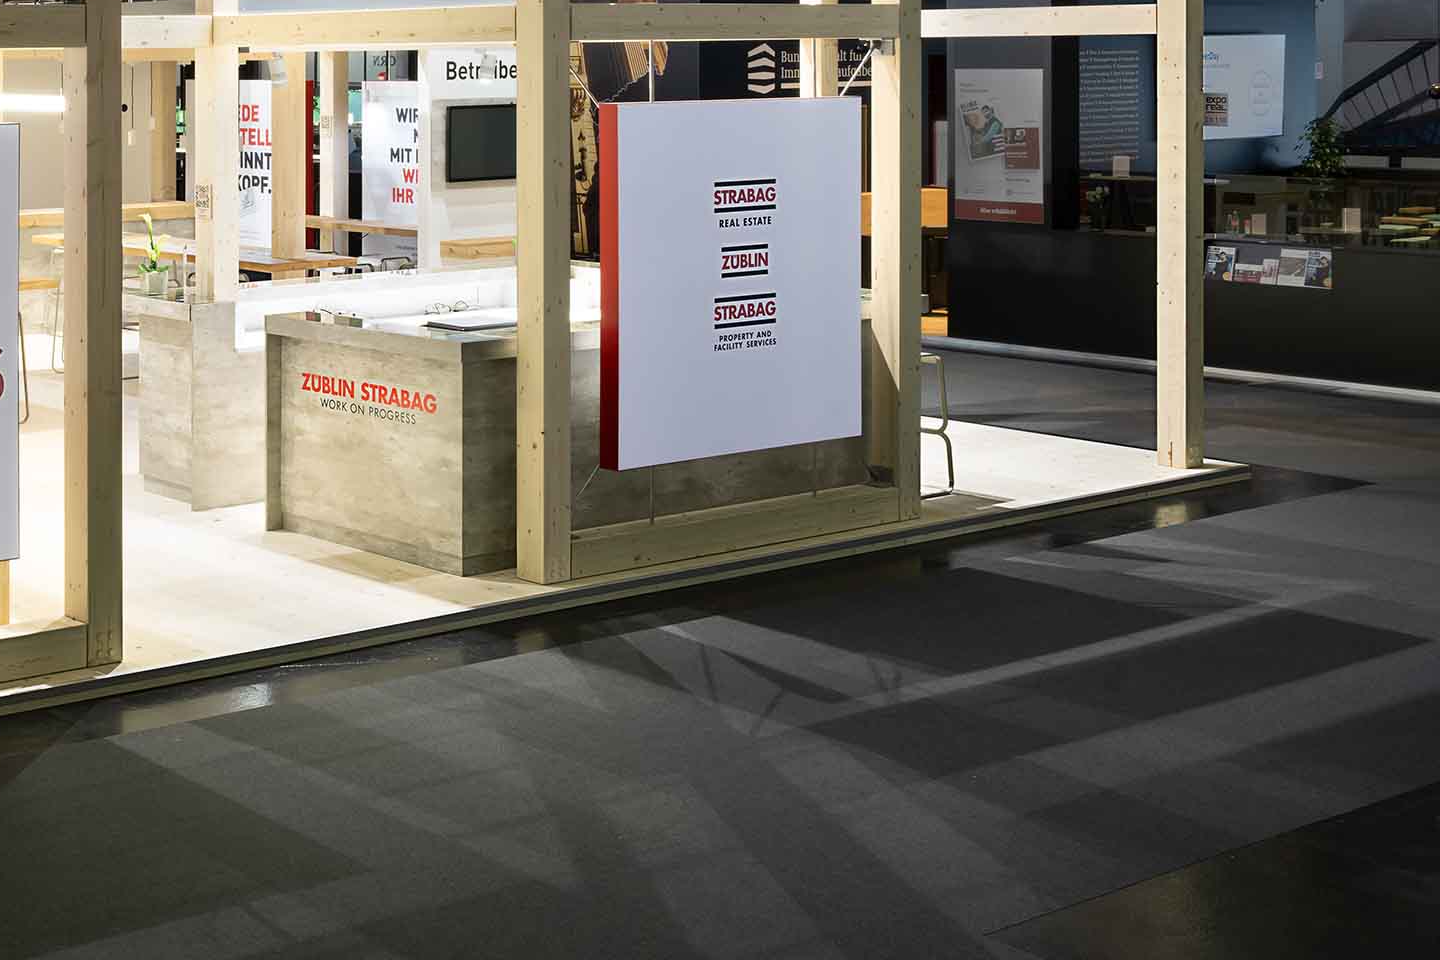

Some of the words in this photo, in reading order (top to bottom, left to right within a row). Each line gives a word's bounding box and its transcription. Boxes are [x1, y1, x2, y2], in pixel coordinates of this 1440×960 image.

[446, 59, 518, 81] Betribe
[390, 147, 412, 163] MIT
[392, 187, 414, 204] IHR
[714, 186, 776, 205] STRABAG
[719, 217, 740, 228] REAL
[743, 215, 772, 227] ESTATE
[721, 251, 769, 270] ZÜBLIN
[714, 300, 776, 321] STRABAG
[714, 341, 743, 352] FACILITY
[746, 338, 777, 349] SERVICES
[719, 331, 755, 342] PROPERTY
[757, 330, 772, 339] AND
[361, 382, 438, 414] STRABAG
[320, 397, 347, 413] WORK
[349, 403, 365, 416] ON
[369, 406, 416, 425] PROGRESS
